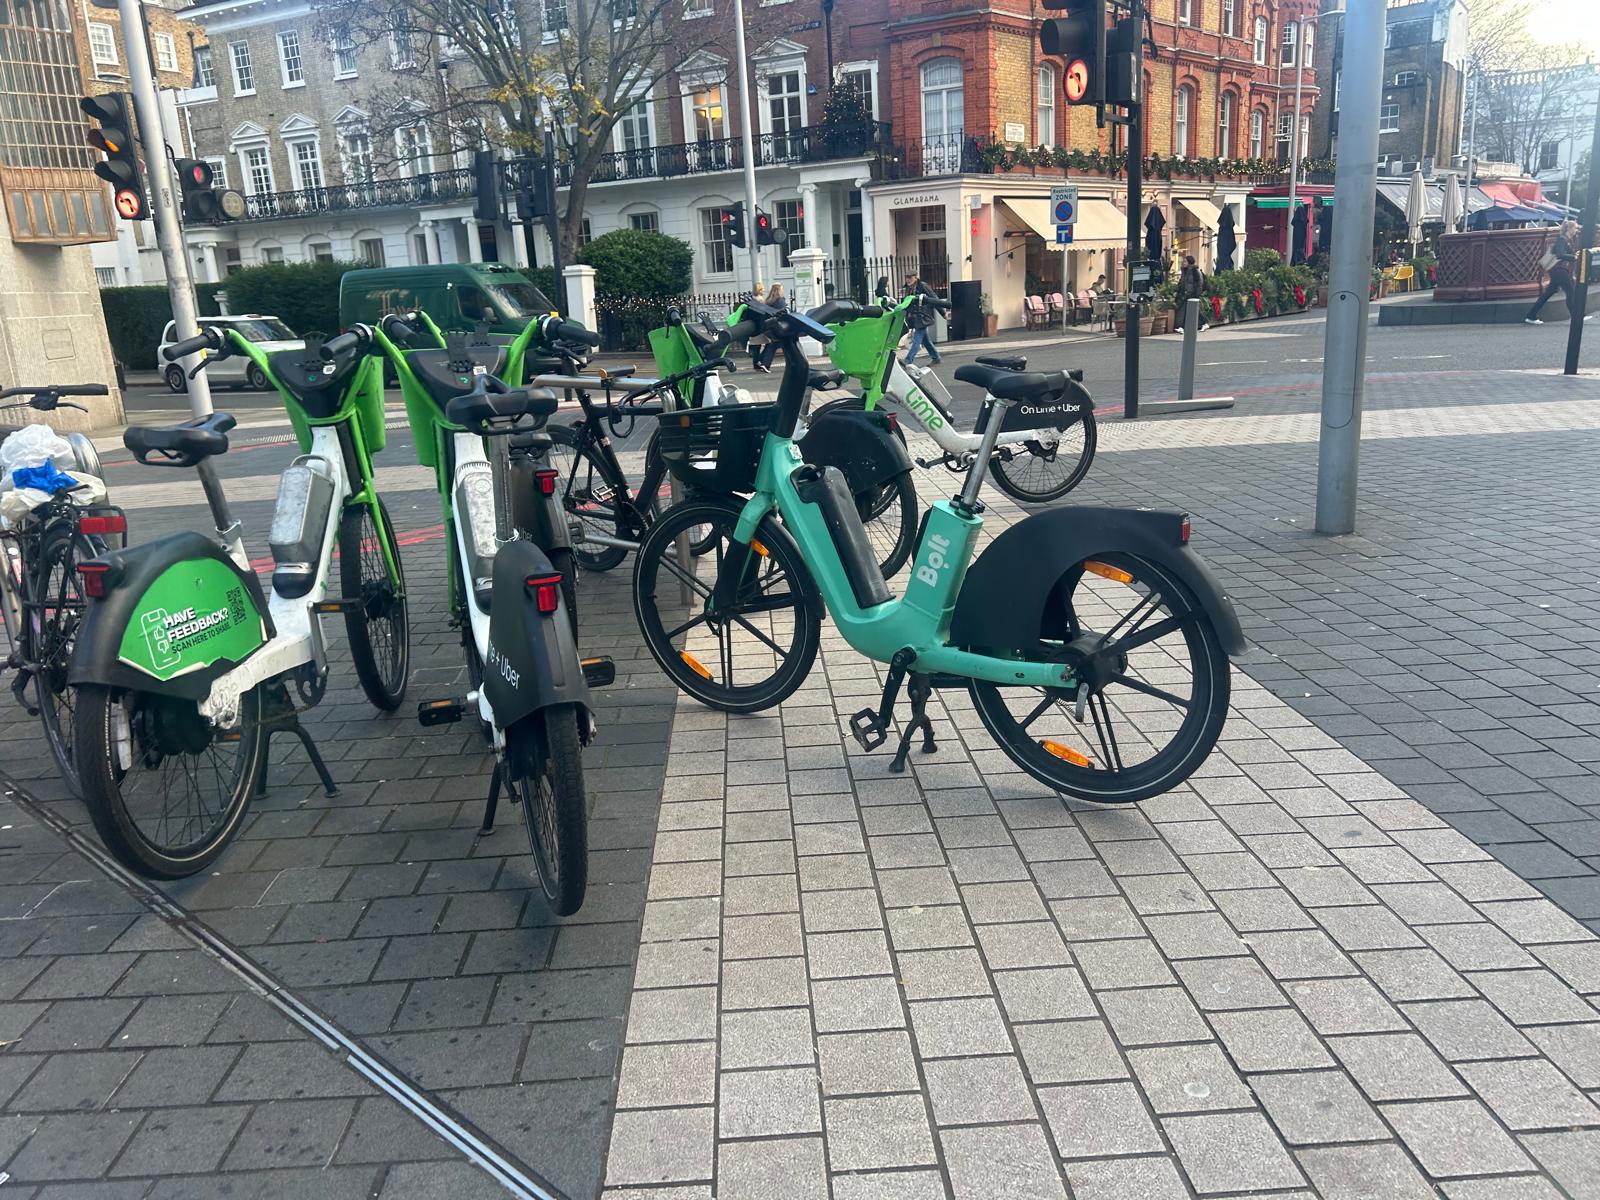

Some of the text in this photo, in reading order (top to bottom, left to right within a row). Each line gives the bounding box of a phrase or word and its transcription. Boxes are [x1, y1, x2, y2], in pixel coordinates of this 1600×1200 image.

[893, 194, 940, 206] GLAMARAMA
[905, 386, 945, 431] Lime
[1020, 405, 1035, 415] On
[1062, 403, 1081, 412] Uber
[916, 533, 951, 588] Bolt
[163, 607, 197, 630] HAVE
[167, 607, 229, 643] FEEDBACK?
[171, 638, 193, 654] SCAN
[192, 632, 208, 646] HERE
[207, 629, 216, 640] TO
[500, 654, 521, 690] Uber
